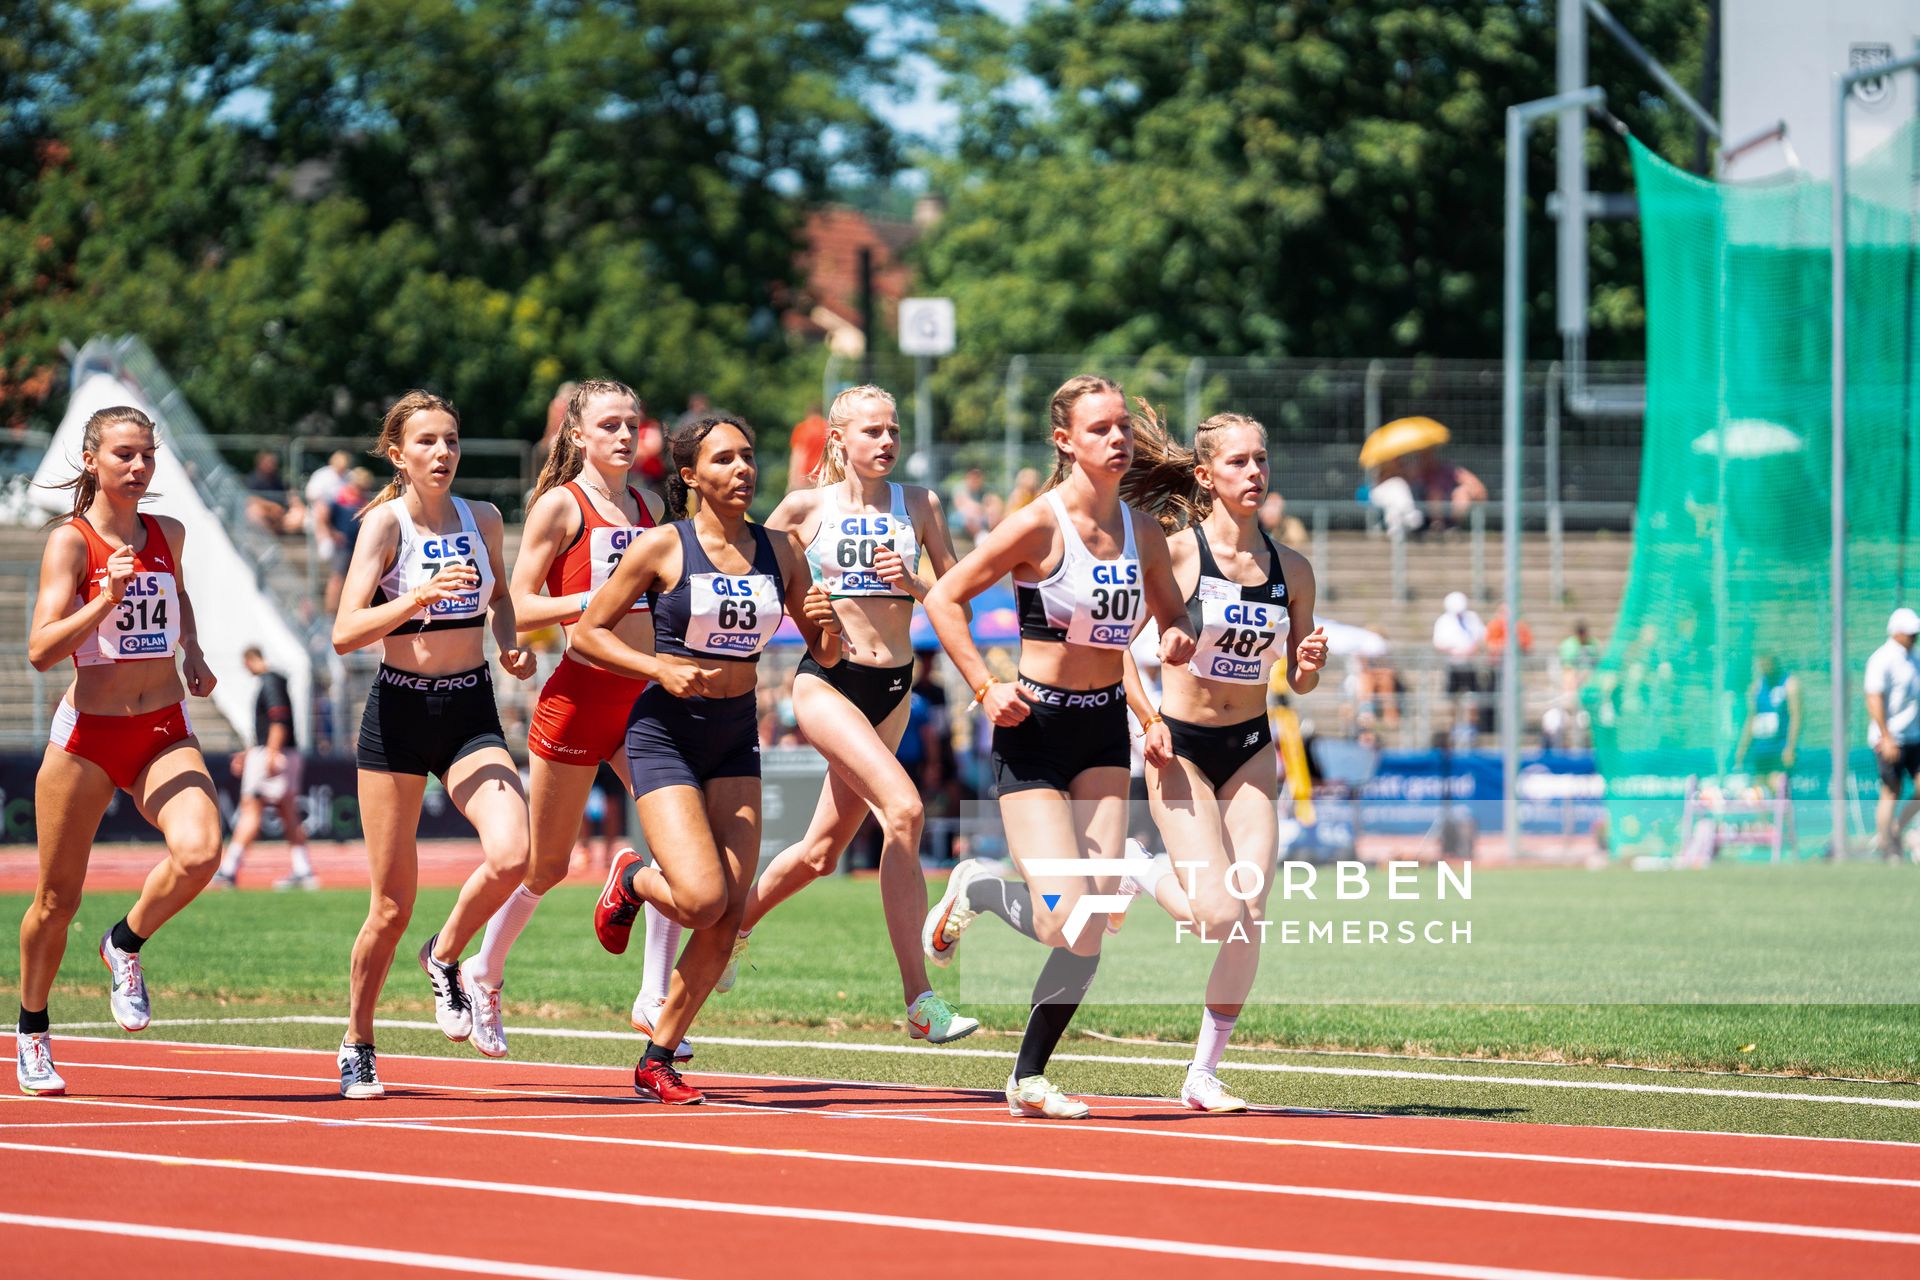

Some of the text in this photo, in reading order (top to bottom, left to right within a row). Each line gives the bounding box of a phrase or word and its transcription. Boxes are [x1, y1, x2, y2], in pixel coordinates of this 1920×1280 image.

[611, 530, 643, 549] GL
[451, 597, 478, 608] PLAN
[1091, 588, 1141, 621] 307
[116, 599, 167, 631] 314
[719, 600, 757, 630] 63
[141, 636, 165, 646] PLAN
[729, 636, 758, 645] PLAN
[1214, 628, 1276, 658] 487
[1234, 663, 1260, 673] PLAN
[381, 669, 431, 691] NIKE
[433, 674, 478, 691] PRO
[1065, 692, 1109, 708] PRO
